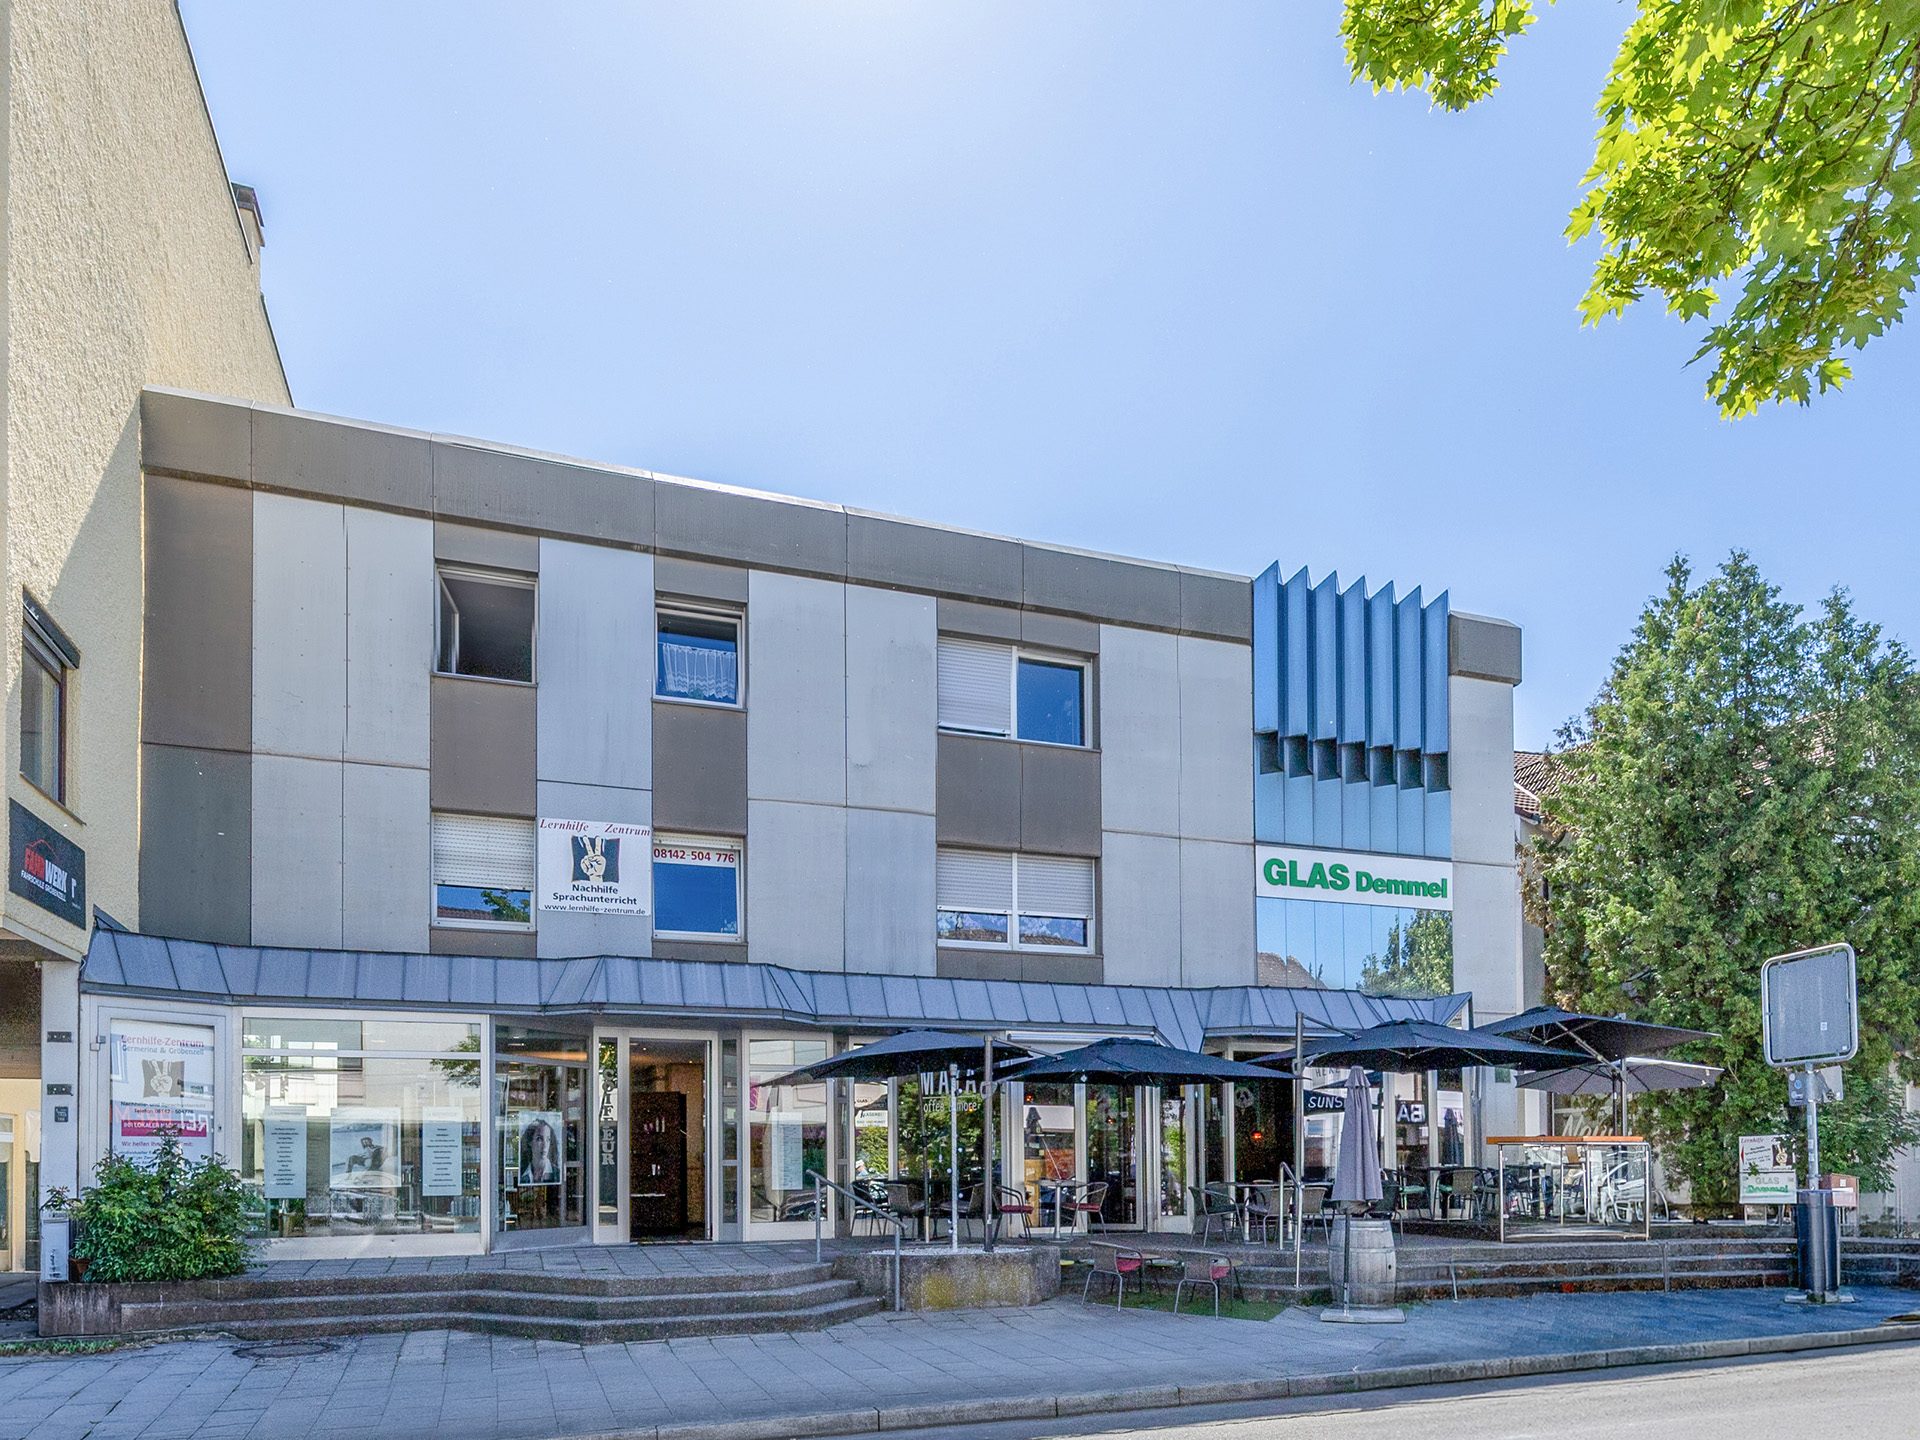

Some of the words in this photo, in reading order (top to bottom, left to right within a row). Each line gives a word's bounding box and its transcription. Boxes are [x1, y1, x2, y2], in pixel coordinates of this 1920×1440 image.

[539, 819, 589, 832] Lernhilfe
[604, 823, 651, 836] Zentrum
[716, 852, 735, 863] 776
[1263, 857, 1350, 891] GLAS
[1355, 870, 1448, 899] Demmel
[572, 884, 618, 895] Nachhilfe
[552, 892, 637, 905] Sprachunterricht
[544, 903, 646, 915] www.lernhilfe-zentrum.de
[121, 1035, 205, 1048] Lernhilfe-Zentrum
[1755, 1176, 1780, 1185] GLAS
